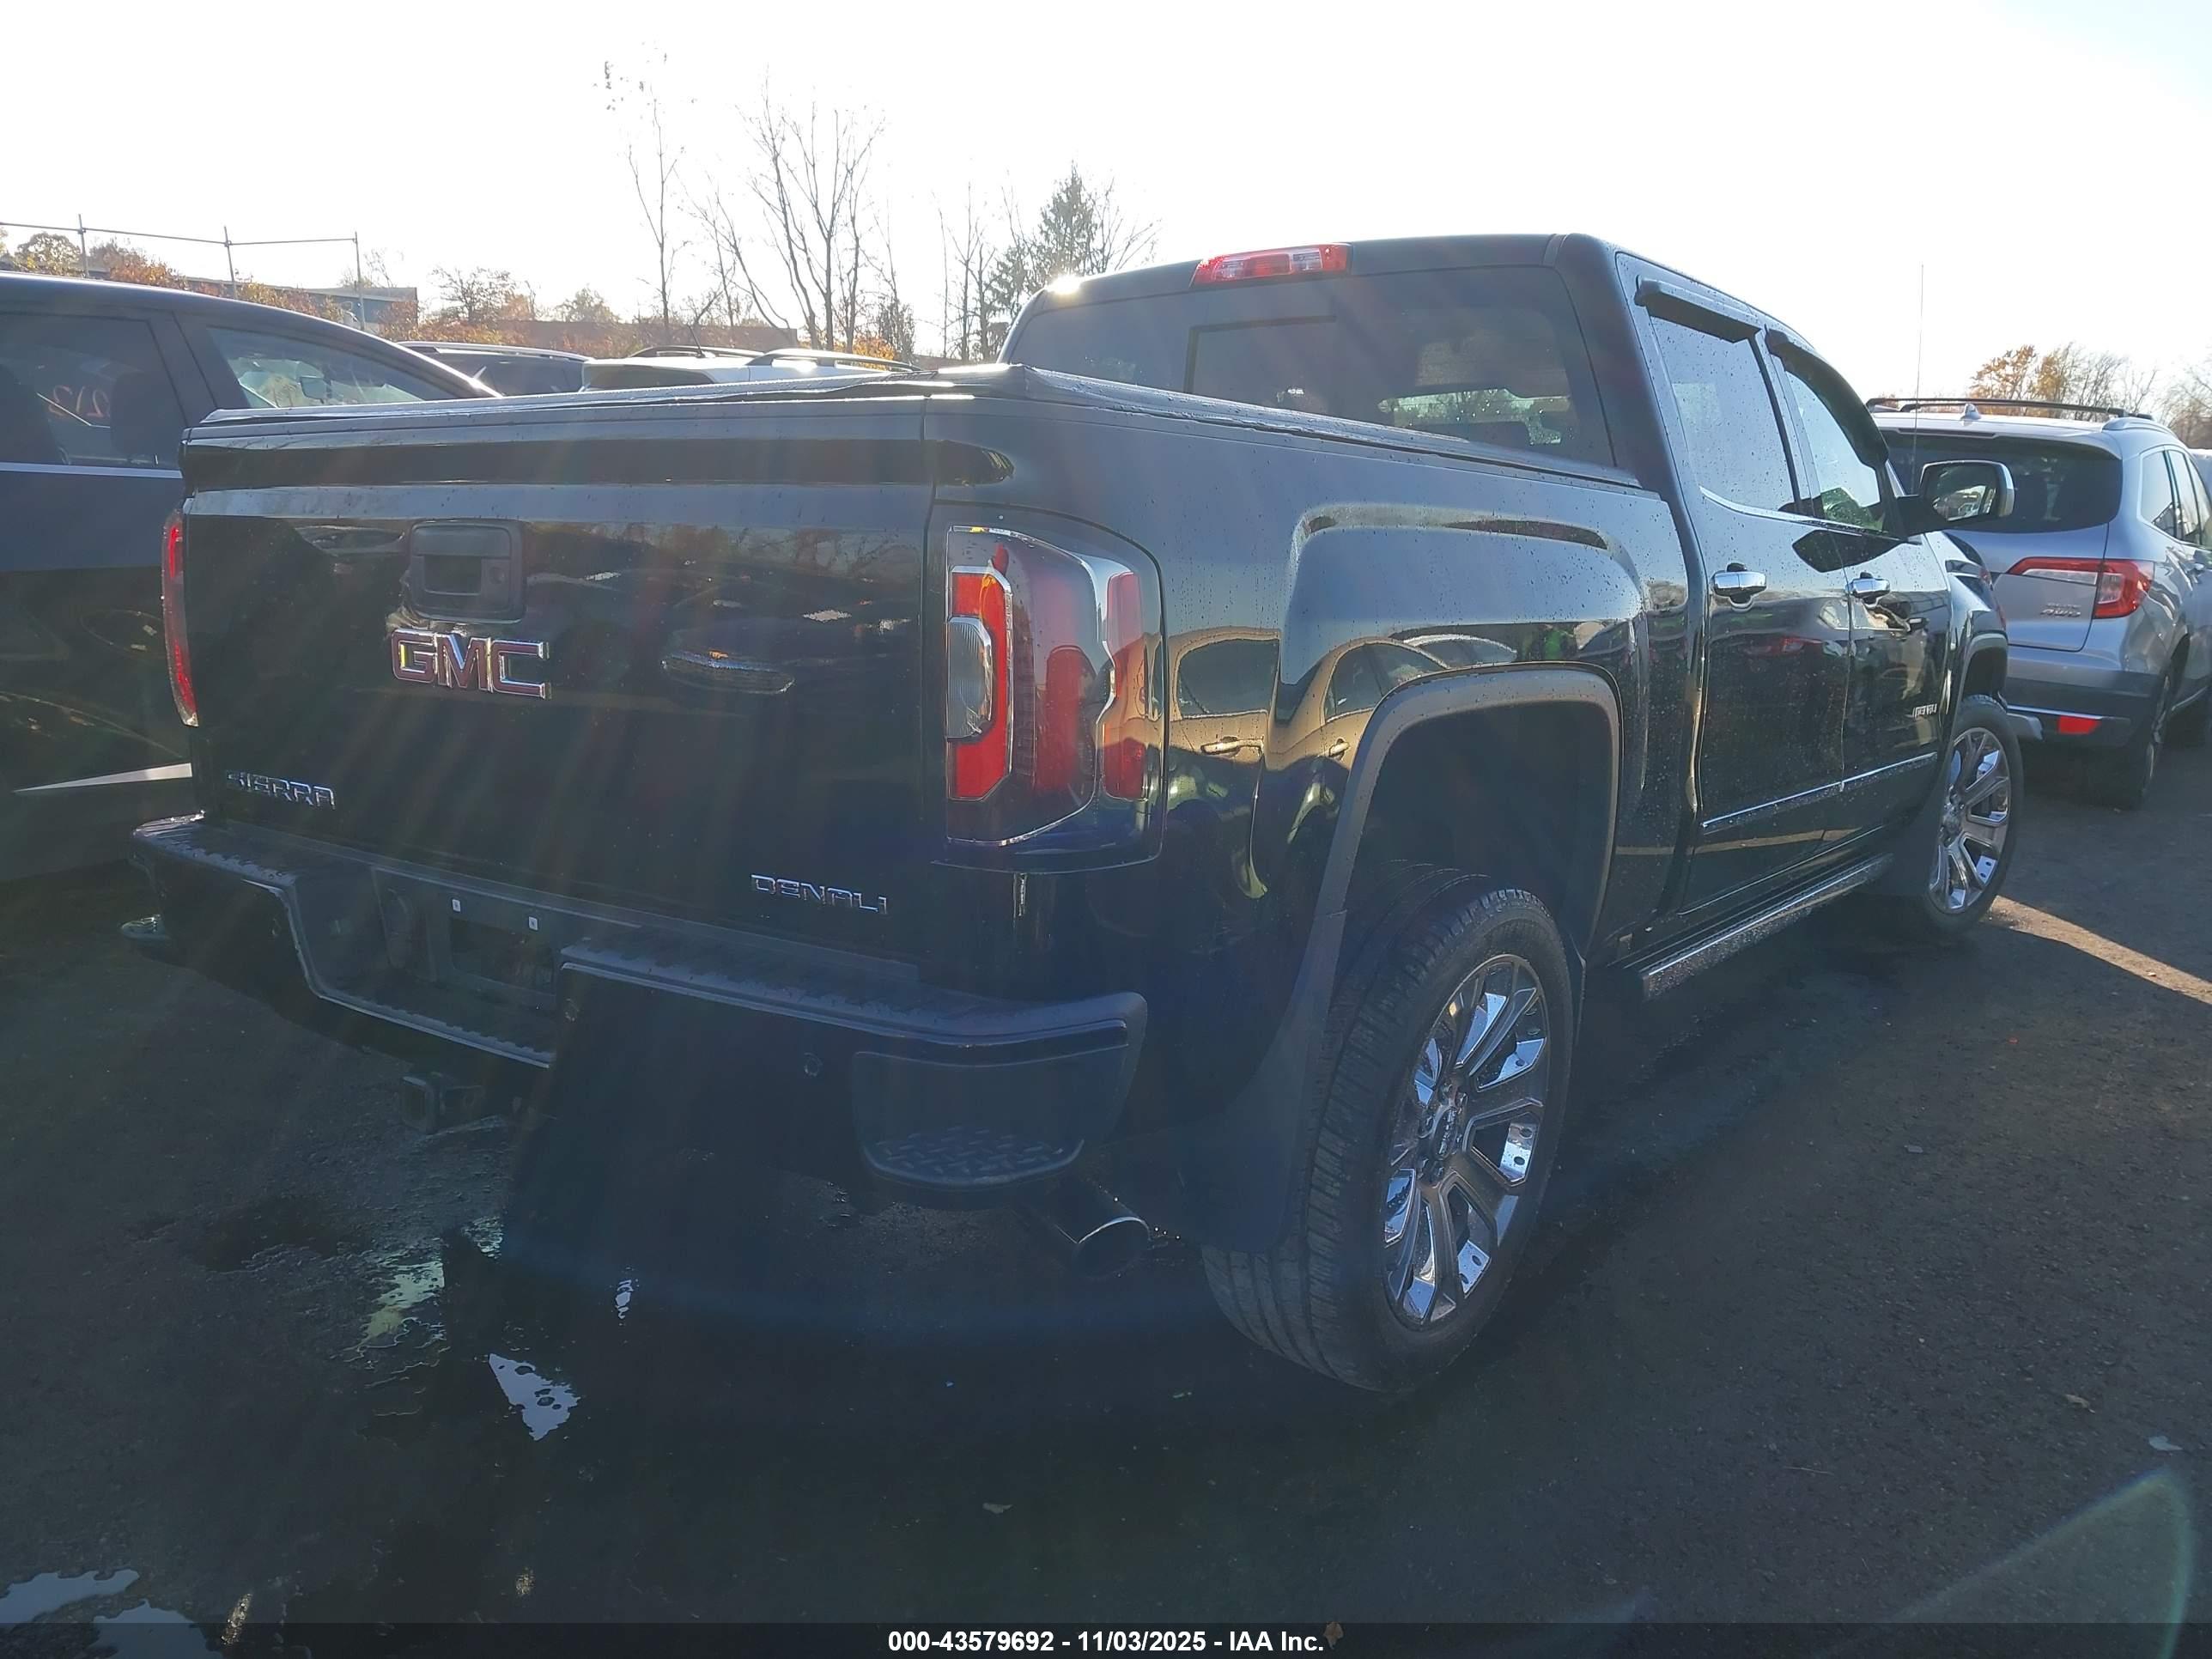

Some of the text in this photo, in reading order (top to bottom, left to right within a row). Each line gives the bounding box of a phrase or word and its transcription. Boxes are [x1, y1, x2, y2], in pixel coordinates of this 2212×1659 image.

[391, 628, 552, 700] GMC
[226, 770, 336, 810] SIERRA
[751, 874, 888, 915] DENALI
